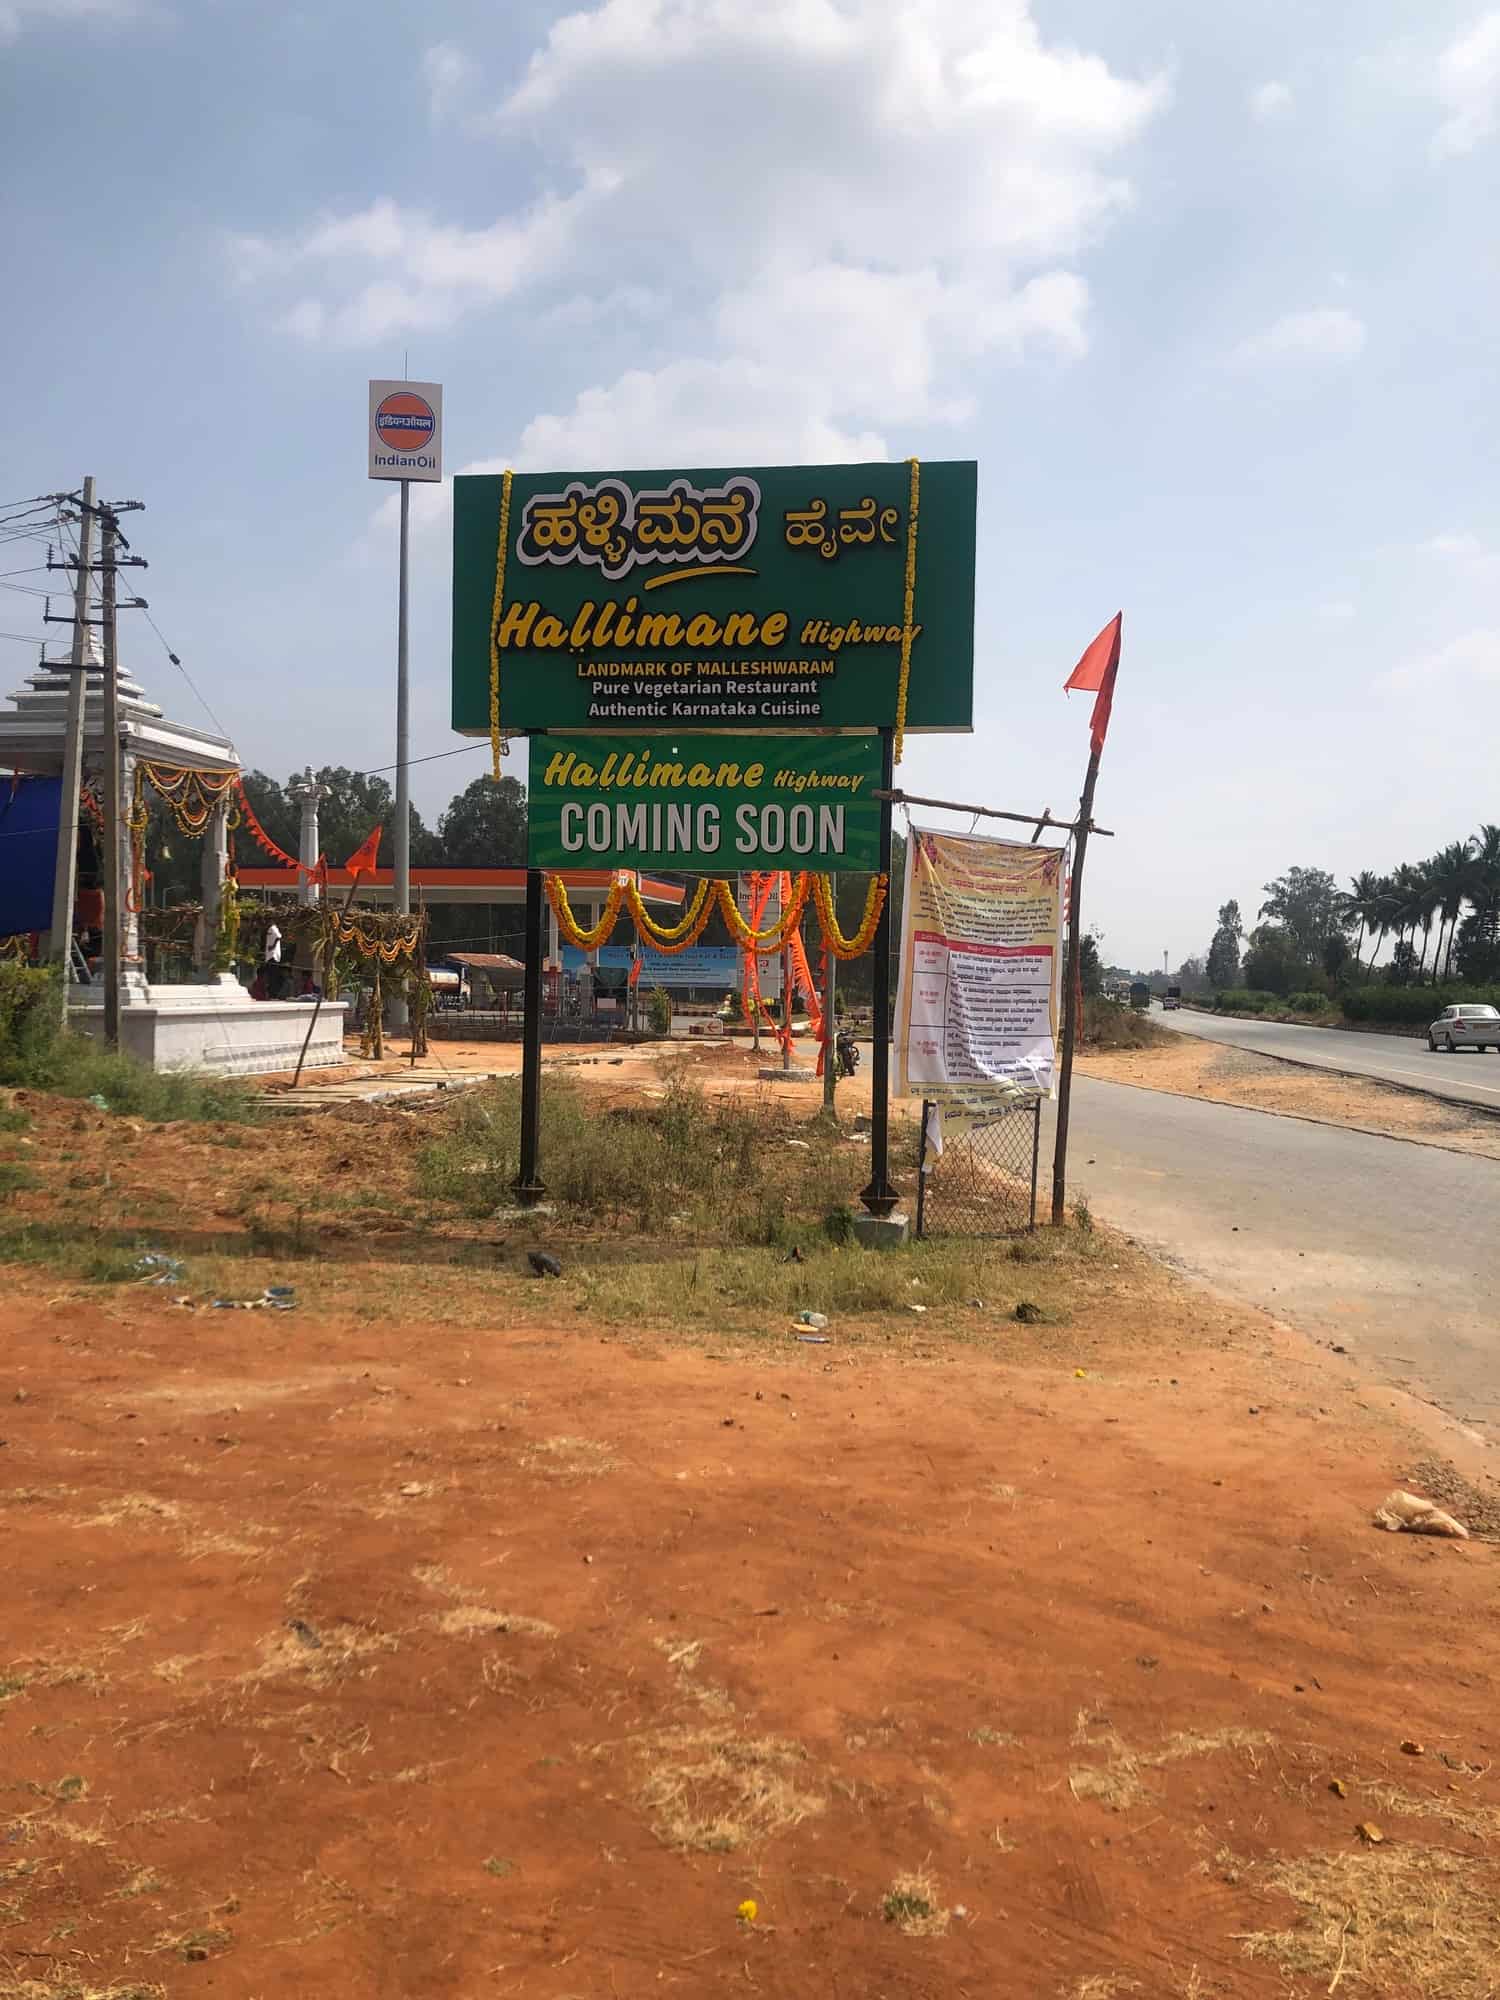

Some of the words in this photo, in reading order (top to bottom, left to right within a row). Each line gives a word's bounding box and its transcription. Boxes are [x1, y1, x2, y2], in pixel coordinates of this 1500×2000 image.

[375, 454, 436, 468] IndianOil
[785, 498, 898, 558] ಹೈವೇ
[577, 662, 667, 677] LANDMARK
[671, 661, 693, 676] OF
[697, 660, 834, 676] MALLESHWARAM
[592, 681, 629, 694] Pure
[633, 679, 721, 698] Vegetarian
[726, 679, 818, 694] Restaurant
[588, 701, 667, 716] Authentic
[672, 700, 757, 716] Karnataka
[760, 699, 821, 715] Cuisine
[543, 750, 764, 791] Hallimane
[773, 769, 865, 793] Highway
[560, 802, 720, 853] COMING
[735, 804, 845, 854] SOON
